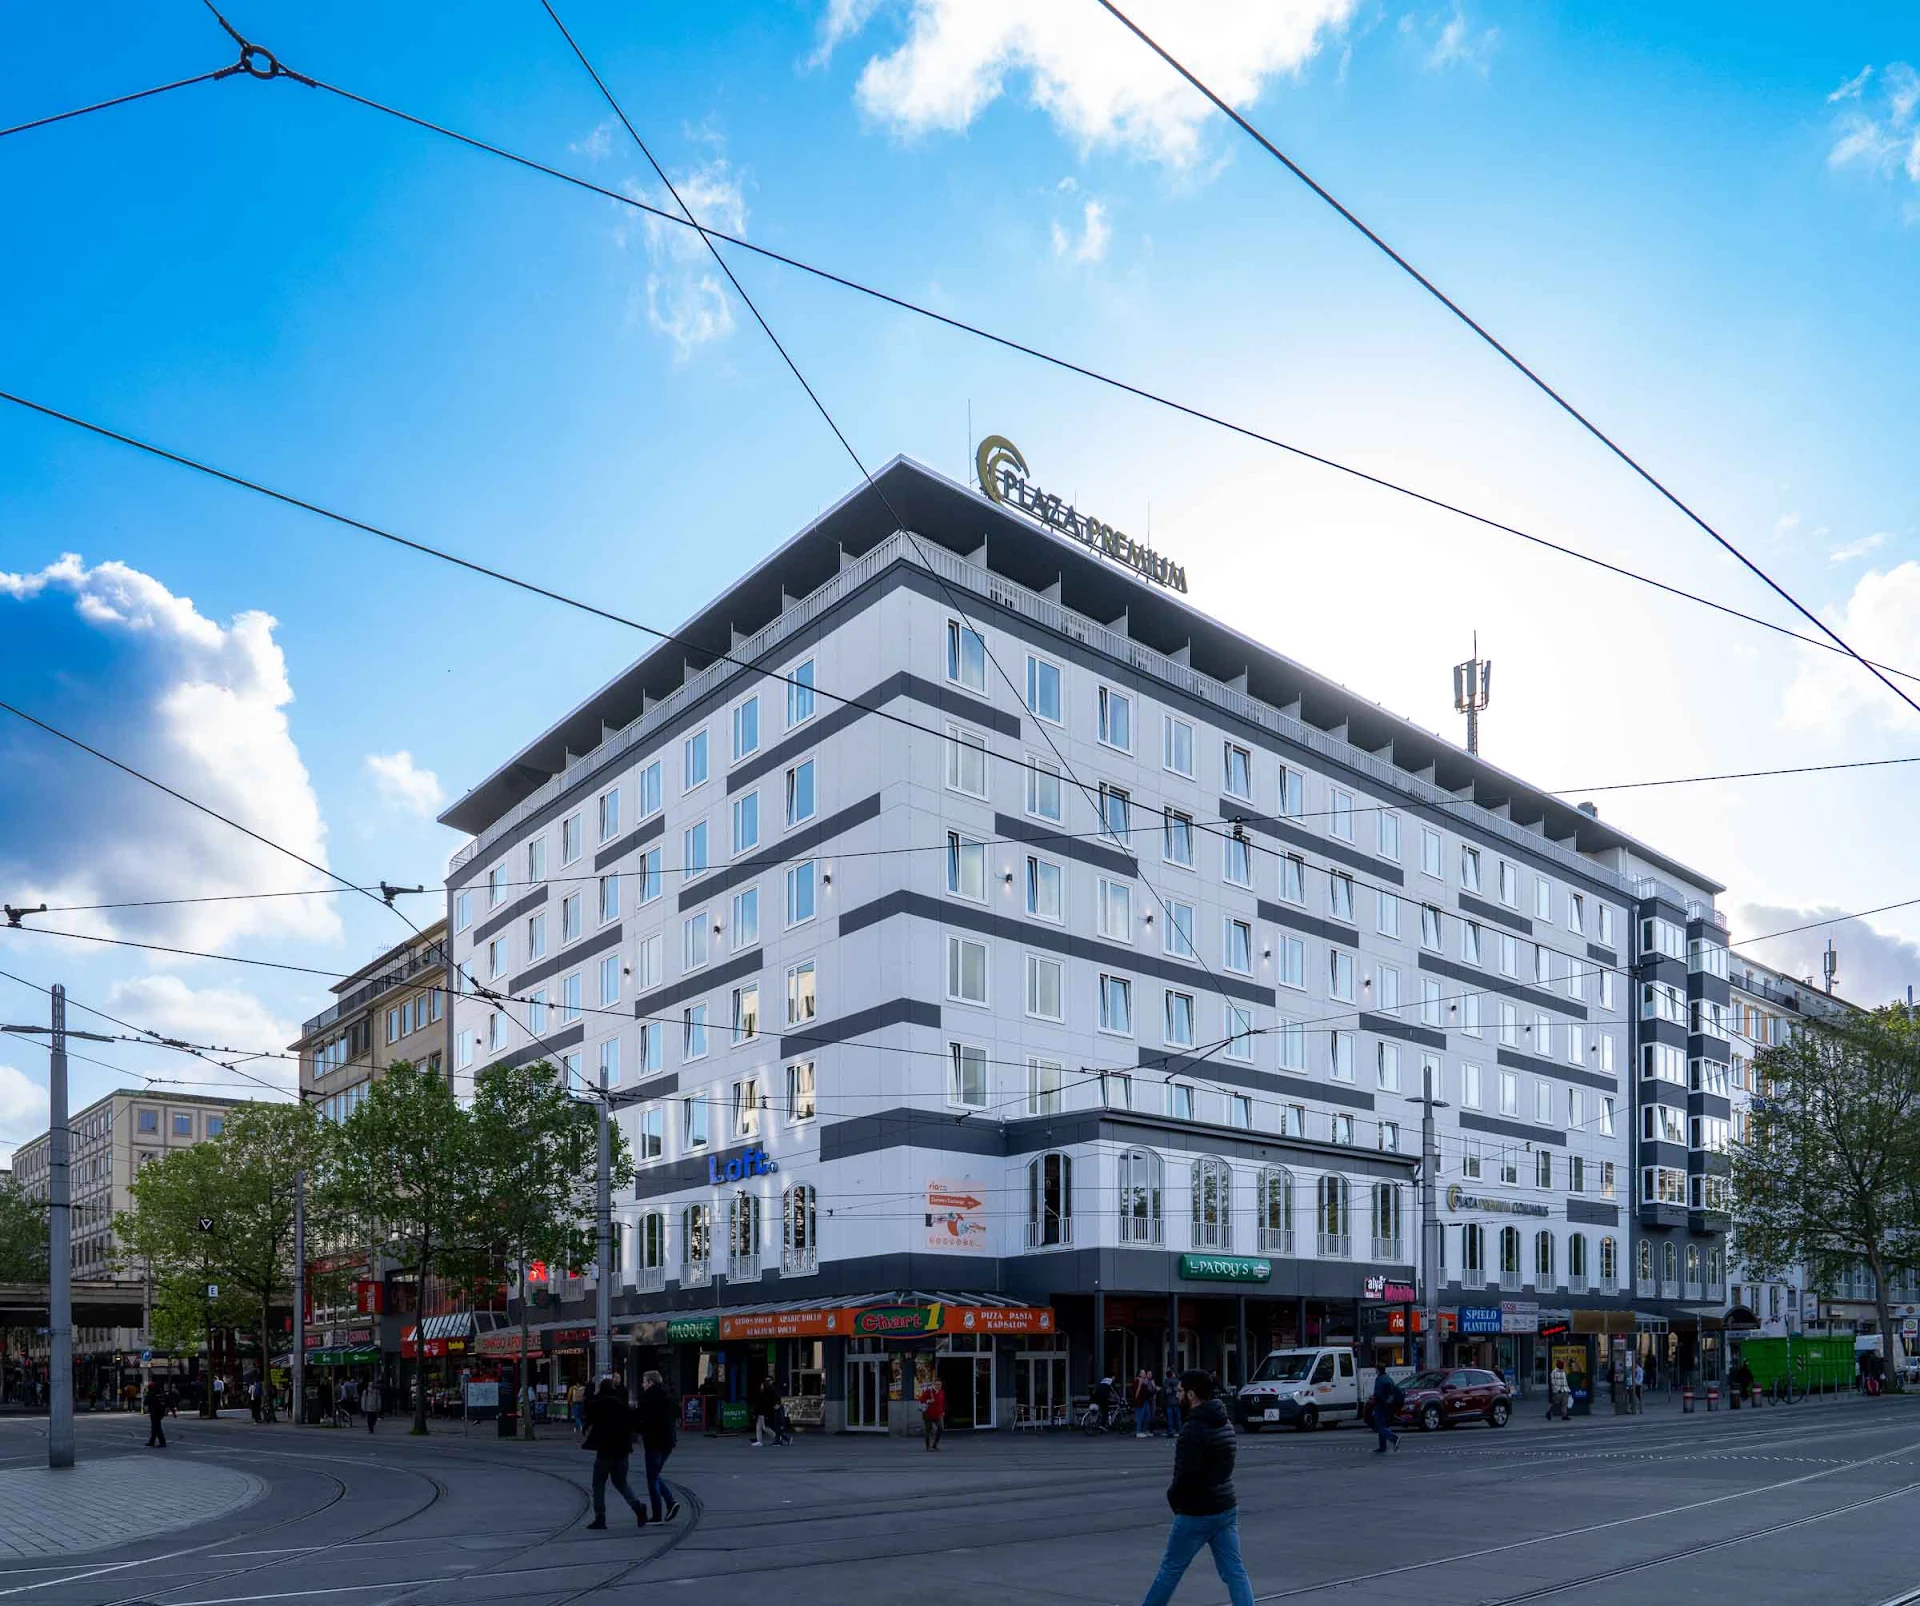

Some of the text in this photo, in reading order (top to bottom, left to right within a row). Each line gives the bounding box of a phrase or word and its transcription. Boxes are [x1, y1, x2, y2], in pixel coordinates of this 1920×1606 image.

[1002, 468, 1188, 594] PLAZA PREMIUM
[1199, 1261, 1249, 1278] PADDY'S
[861, 1302, 942, 1332] Chart 1
[980, 1311, 1033, 1321] PIZZA PASTA
[1465, 1309, 1497, 1320] SPIELO
